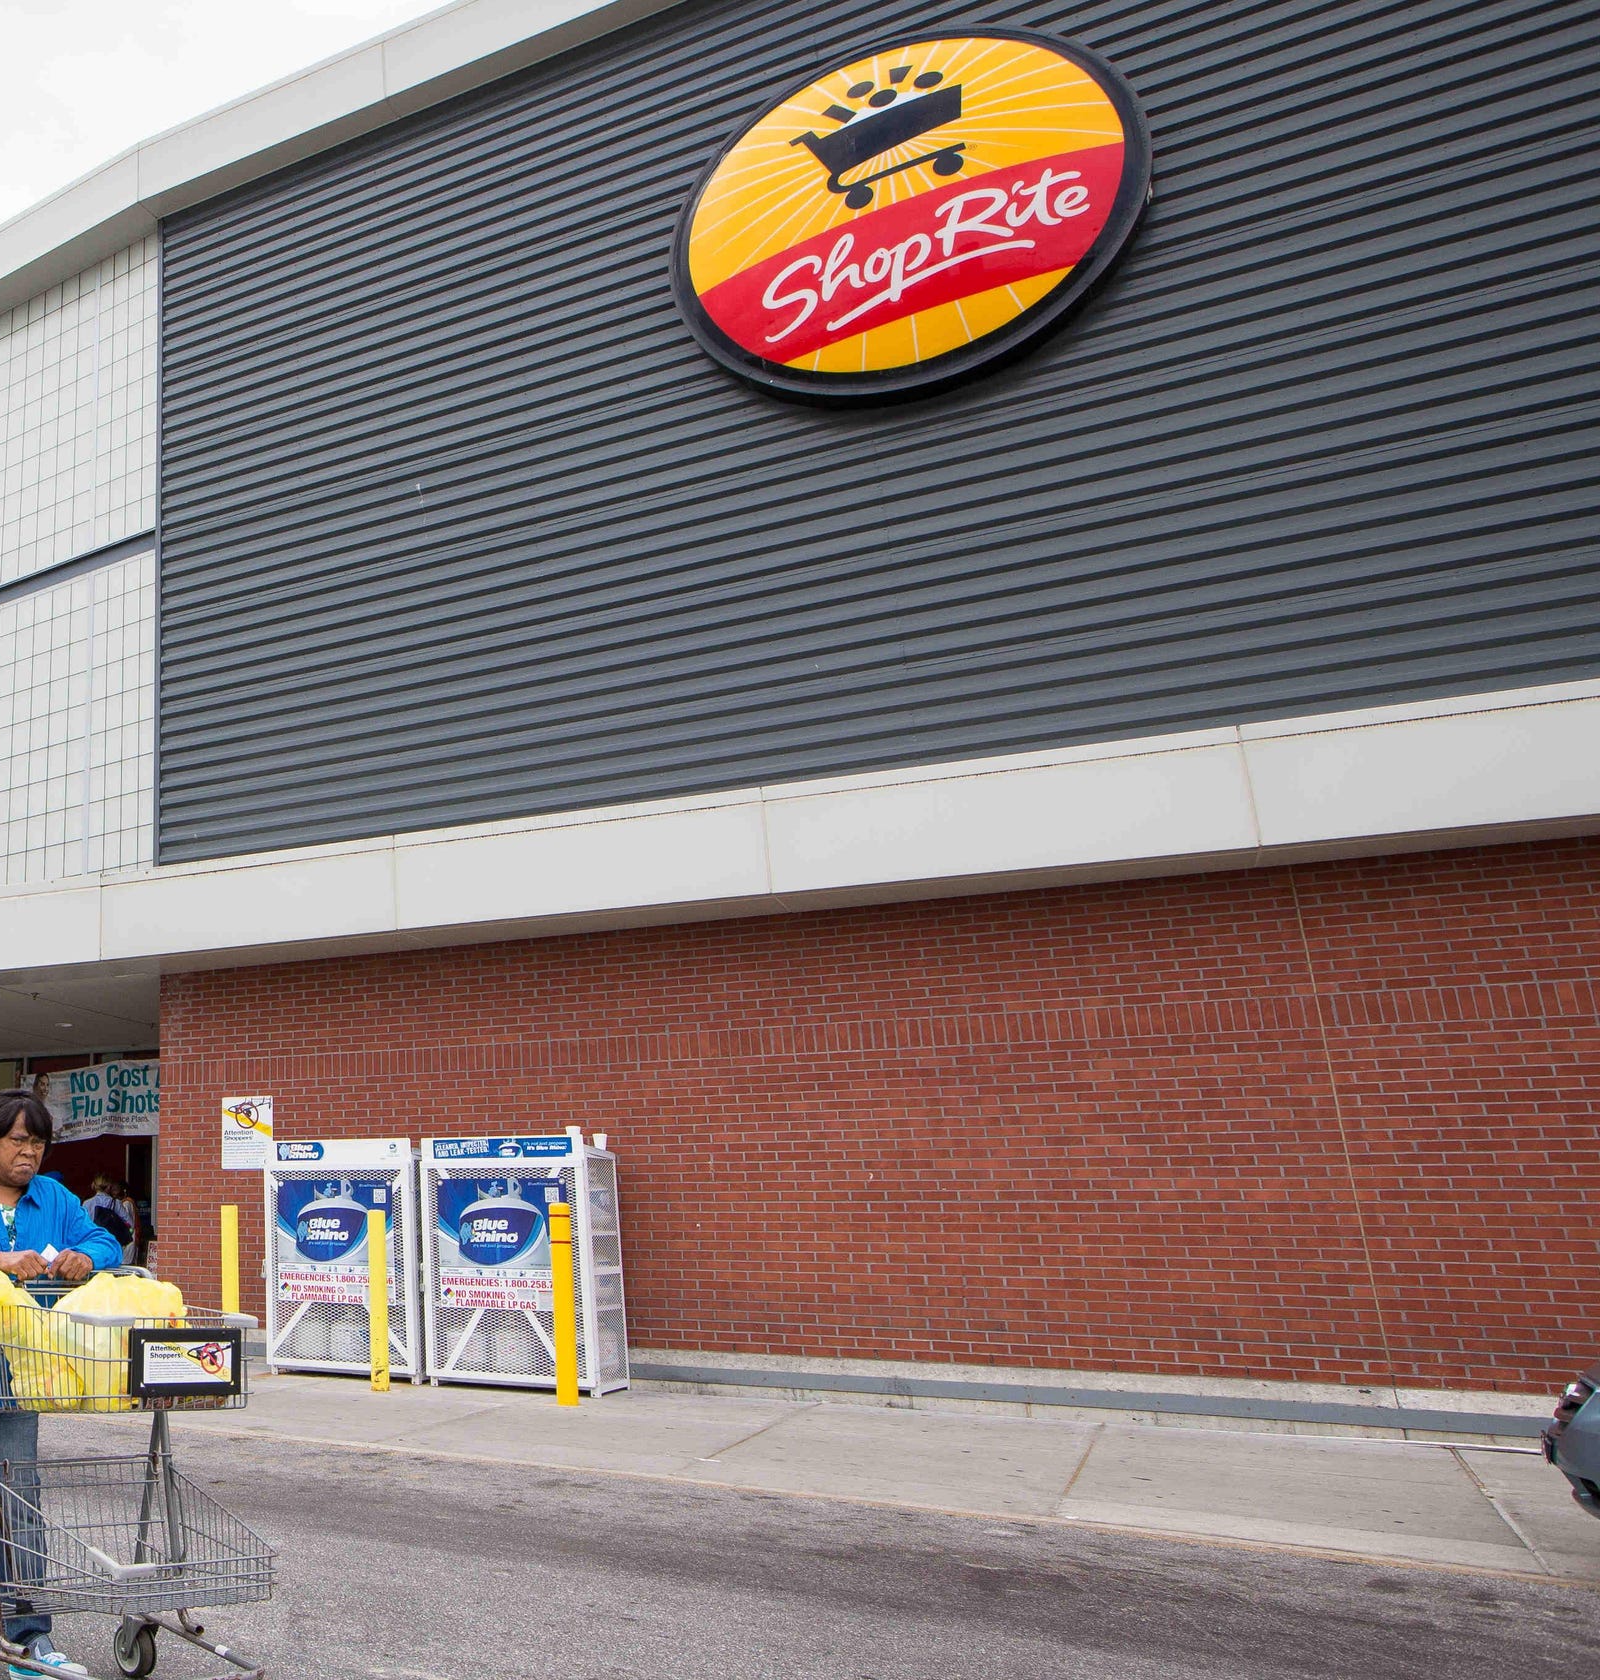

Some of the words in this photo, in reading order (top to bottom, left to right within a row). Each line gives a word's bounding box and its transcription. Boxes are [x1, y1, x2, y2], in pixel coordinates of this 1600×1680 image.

[70, 1071, 100, 1093] No
[106, 1064, 149, 1088] Cost
[71, 1095, 102, 1119] Flu
[308, 1217, 341, 1229] Blue
[472, 1218, 509, 1231] Blue
[306, 1229, 349, 1241] Rhino
[470, 1229, 518, 1243] Rhino
[280, 1272, 334, 1282] EMERGENCIES:
[441, 1277, 503, 1288] EMERGENCIES:
[303, 1285, 336, 1293] SMOKING
[455, 1290, 466, 1298] NO
[468, 1291, 506, 1299] SMOKING
[291, 1292, 336, 1301] FLAMMABLE
[337, 1294, 347, 1302] LP
[348, 1295, 363, 1303] GAS
[455, 1299, 507, 1308] FLAMMABLE
[508, 1300, 518, 1308] LP
[520, 1301, 537, 1310] GAS
